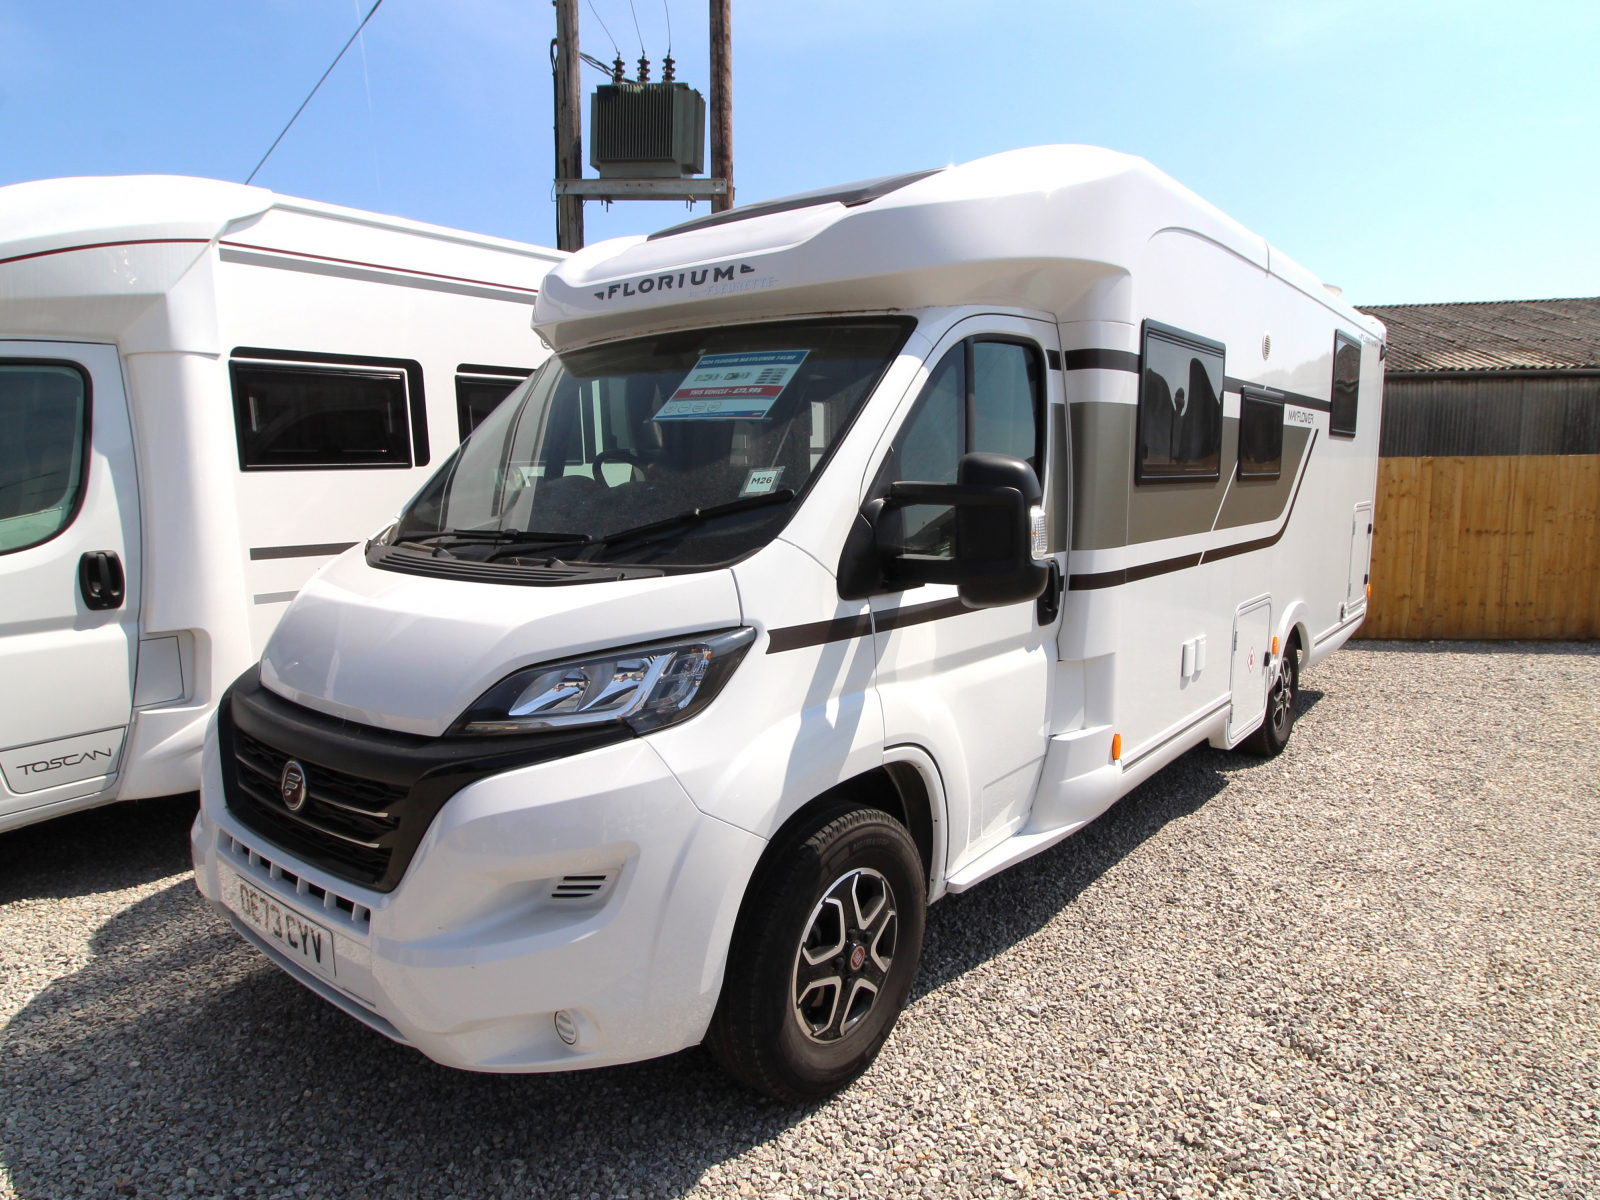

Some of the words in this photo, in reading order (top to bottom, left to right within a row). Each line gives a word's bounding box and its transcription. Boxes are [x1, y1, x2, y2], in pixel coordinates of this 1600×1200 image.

[607, 265, 734, 299] FLORIUM
[1288, 409, 1314, 424] MAYFLOWER
[16, 748, 112, 775] TOSCAN
[285, 914, 321, 964] CYV
